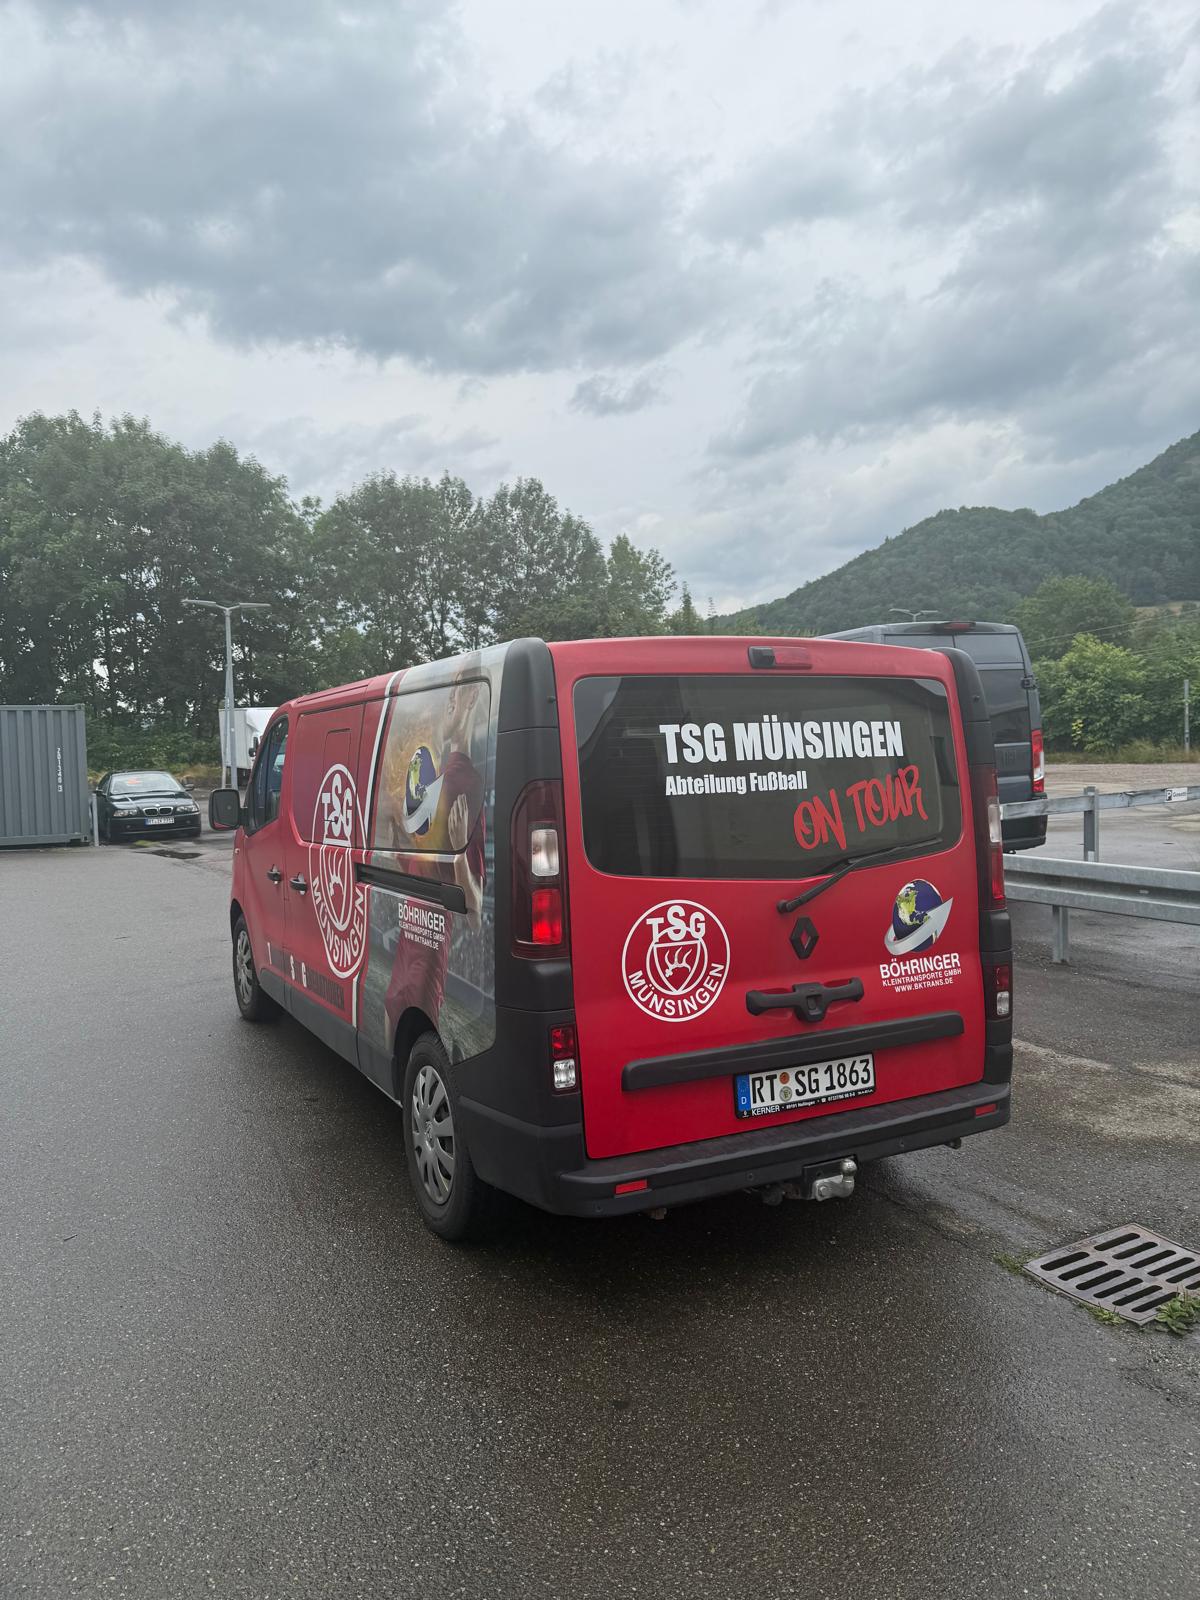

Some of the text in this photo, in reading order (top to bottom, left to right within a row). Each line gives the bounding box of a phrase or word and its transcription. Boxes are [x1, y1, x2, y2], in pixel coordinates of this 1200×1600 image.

[659, 714, 904, 764] TSG MÜNSINGEN
[665, 771, 808, 796] Abteilung Fußball
[321, 773, 352, 839] TSG
[793, 764, 929, 850] ON TOUR
[312, 876, 365, 968] MÜNSINGEN
[398, 900, 445, 933] BÖHRINGER
[646, 904, 706, 943] TSG
[880, 953, 961, 979] BÖHRINGER
[882, 967, 962, 987] KLEINTRANSPORTE GMBH
[628, 962, 725, 1016] MÜNSINGEN
[894, 977, 954, 993] WWW.BKTRANS.DE
[751, 1074, 778, 1104] RT
[751, 1104, 780, 1117] KERNER
